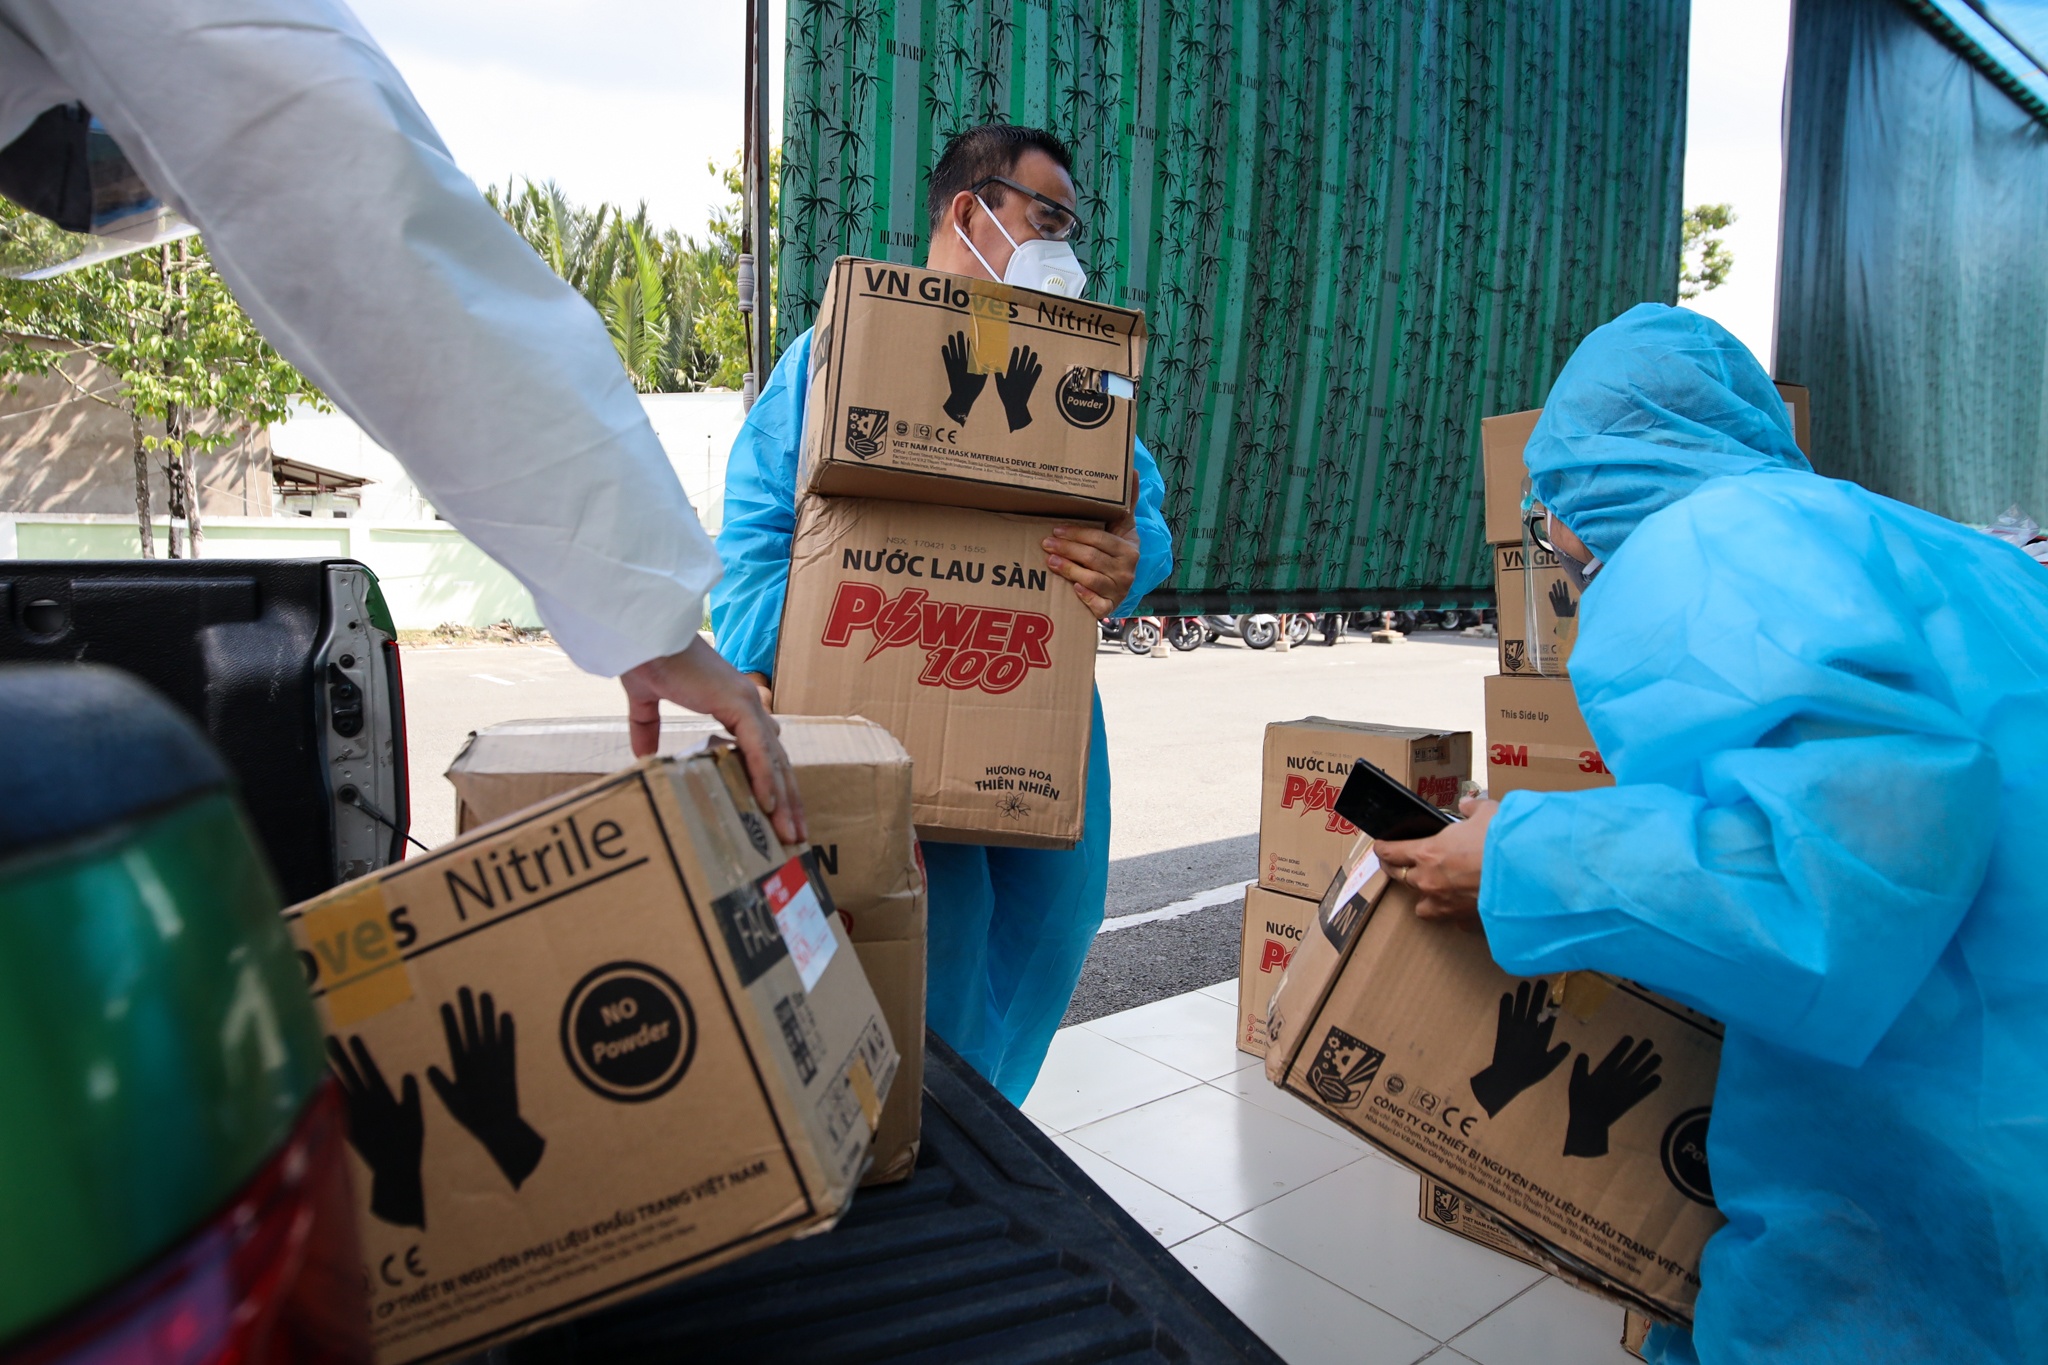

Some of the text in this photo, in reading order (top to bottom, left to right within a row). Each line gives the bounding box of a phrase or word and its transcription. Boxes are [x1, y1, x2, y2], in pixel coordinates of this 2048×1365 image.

[865, 267, 1116, 338] VN Gloves Nitrile
[1067, 395, 1104, 410] Powder
[891, 439, 909, 448] VIET
[909, 442, 928, 451] NAM
[928, 445, 947, 454] FACE
[947, 448, 969, 457] MASK
[970, 452, 1009, 464] MATERIALS
[1010, 458, 1036, 468] DEVICE
[1038, 462, 1059, 471] JOINT
[1059, 466, 1084, 475] STOCK
[1084, 469, 1118, 480] COMPANY
[886, 537, 907, 546] NSX
[842, 548, 1047, 591] NƯỚC LAU SÀN
[821, 581, 1054, 668] POWER
[918, 649, 1030, 694] 100
[1501, 710, 1549, 722] This Side Up
[1287, 756, 1325, 772] NƯỚC
[1490, 744, 1528, 767] 3M
[986, 765, 1052, 782] HƯƠNG HOA
[975, 776, 1060, 800] THIÊN NHIÊN
[1417, 774, 1459, 801] POWER
[444, 815, 627, 921] Nitrile
[1266, 921, 1303, 941] NƯỚC
[600, 997, 638, 1027] NO
[592, 1019, 670, 1065] Powder
[726, 1159, 768, 1186] NAM
[1371, 1093, 1407, 1119] CÔNG
[1403, 1112, 1420, 1127] TY
[1419, 1120, 1437, 1136] CP
[1434, 1128, 1470, 1154] THIẾT
[1466, 1147, 1482, 1163] BỊ
[1480, 1155, 1529, 1188] NGUYÊN
[1527, 1183, 1555, 1205] PHỤ
[1552, 1195, 1582, 1220] LIỆU
[1614, 1232, 1657, 1261] TRANG
[1654, 1253, 1686, 1279] VIỆT
